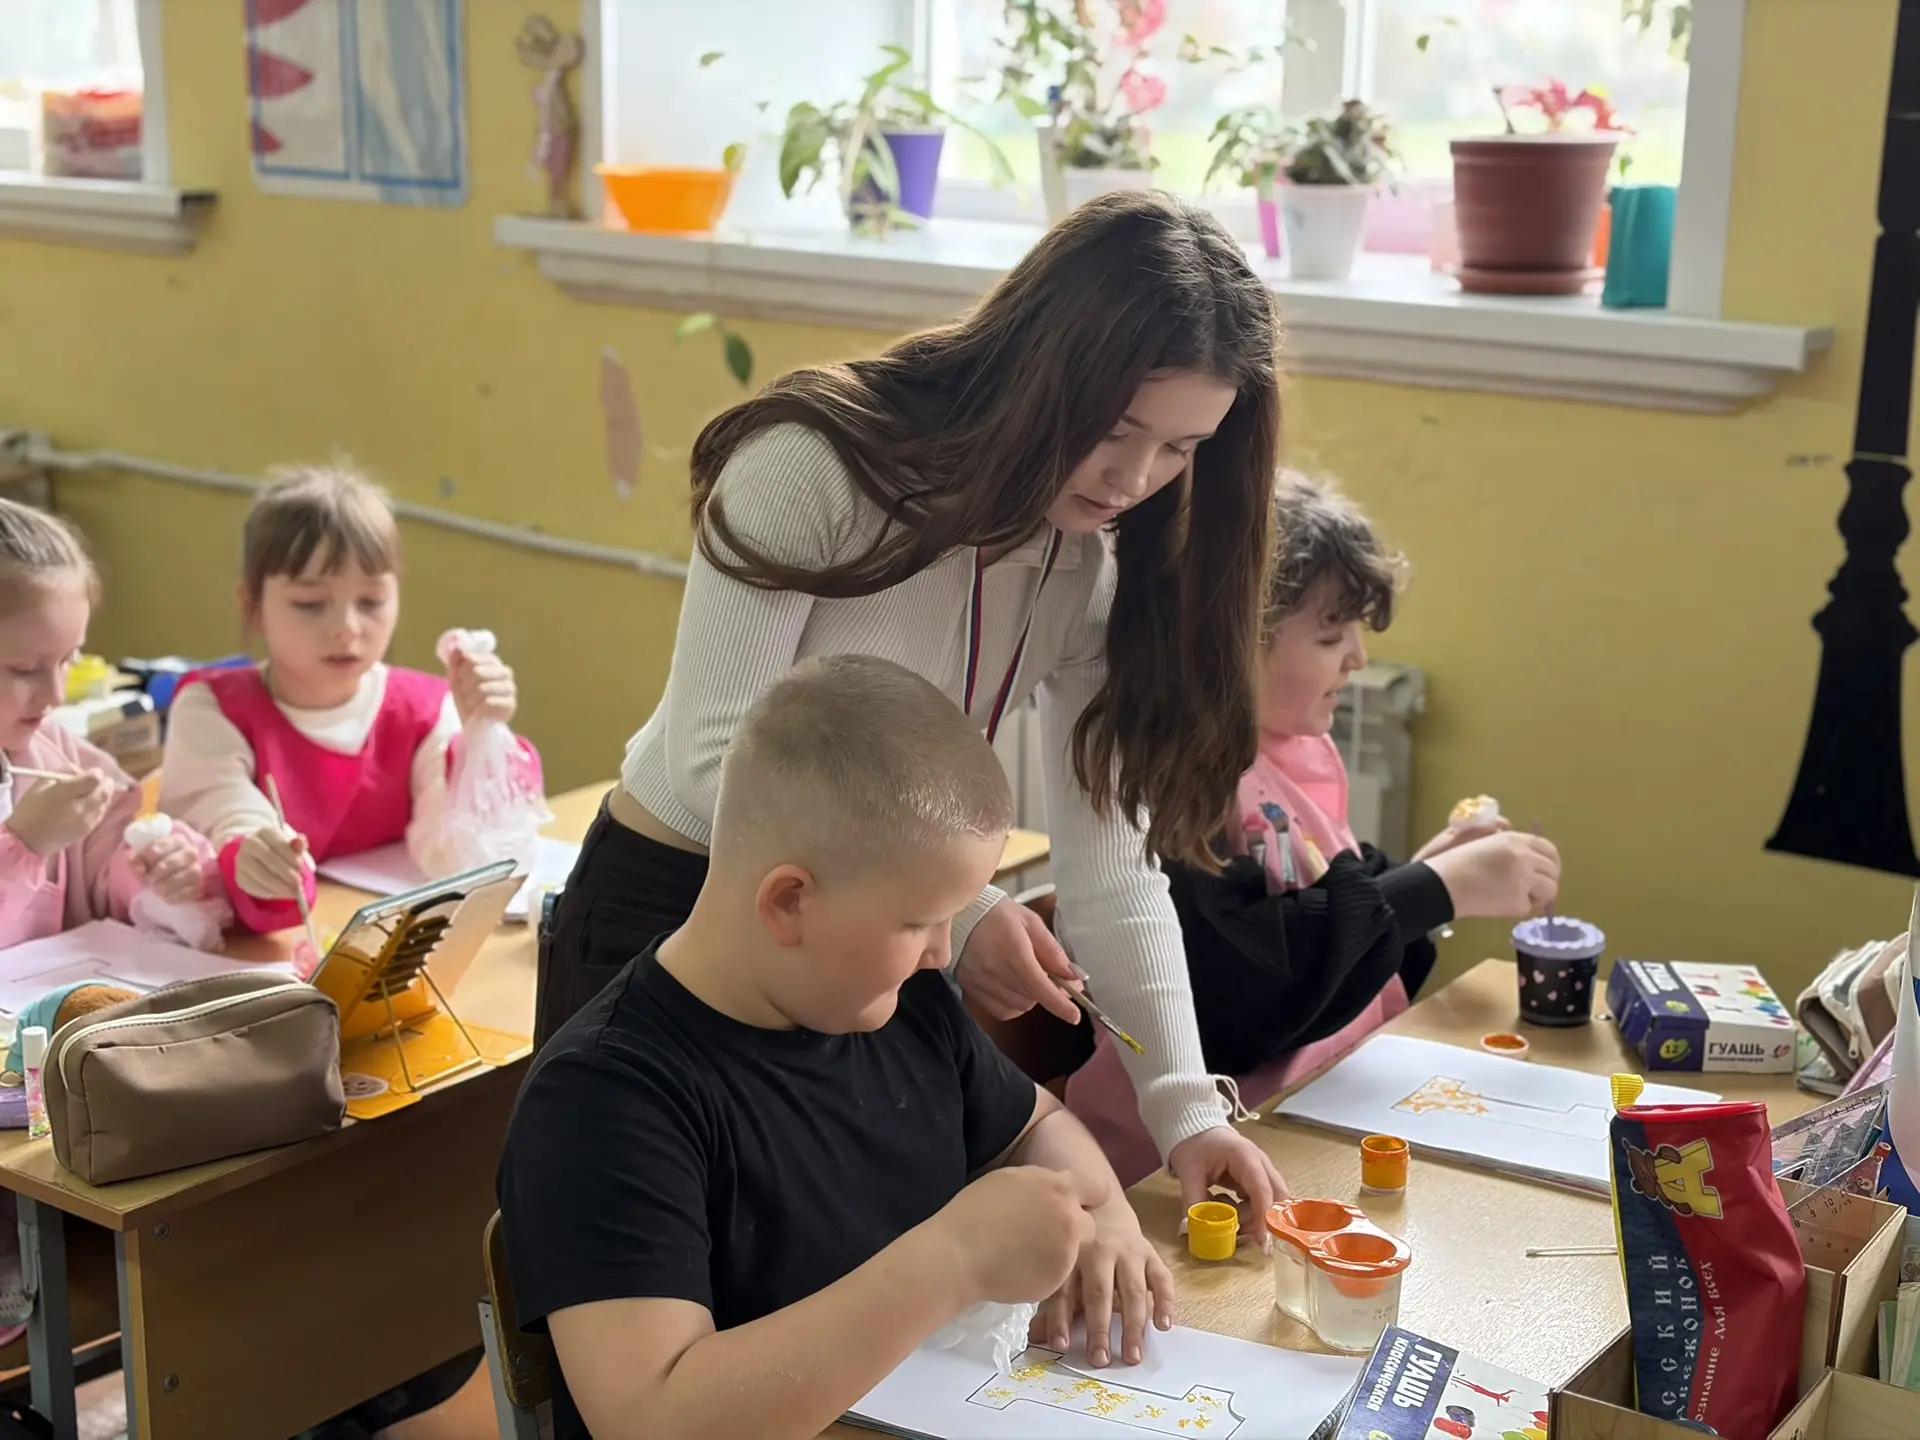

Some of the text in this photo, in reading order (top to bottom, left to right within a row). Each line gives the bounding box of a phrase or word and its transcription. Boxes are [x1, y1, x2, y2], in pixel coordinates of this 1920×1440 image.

[1709, 1042, 1765, 1055] ГУАШЬ
[1794, 1219, 1801, 1228] 8
[1809, 1209, 1817, 1218] 9
[1824, 1197, 1834, 1208] 10
[1647, 1254, 1679, 1406] ССКИЙ
[1673, 1255, 1699, 1421] ДВЕЖОНОК
[1392, 1343, 1443, 1408] ГУАШЬ
[1694, 1347, 1720, 1422] ознание
